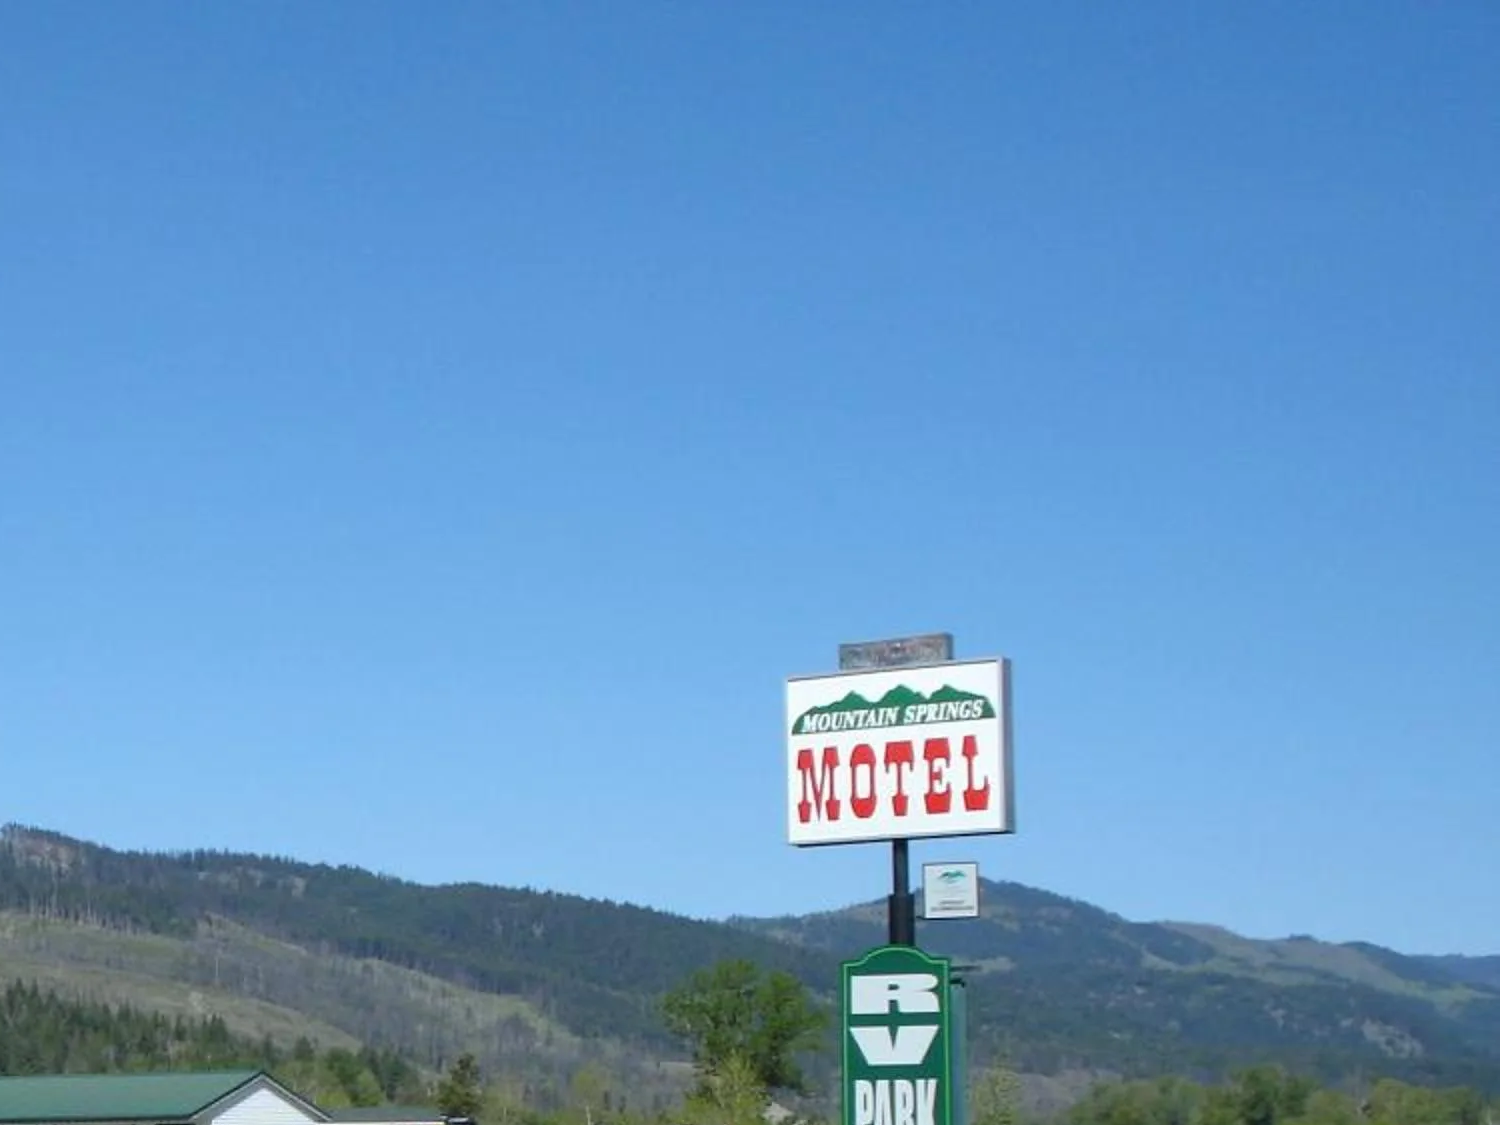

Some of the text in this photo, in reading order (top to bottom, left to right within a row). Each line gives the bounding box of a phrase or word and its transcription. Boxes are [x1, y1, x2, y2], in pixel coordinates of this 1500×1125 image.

[802, 699, 984, 733] MOUNTAIN SPRINGS
[797, 734, 990, 823] MOTEL
